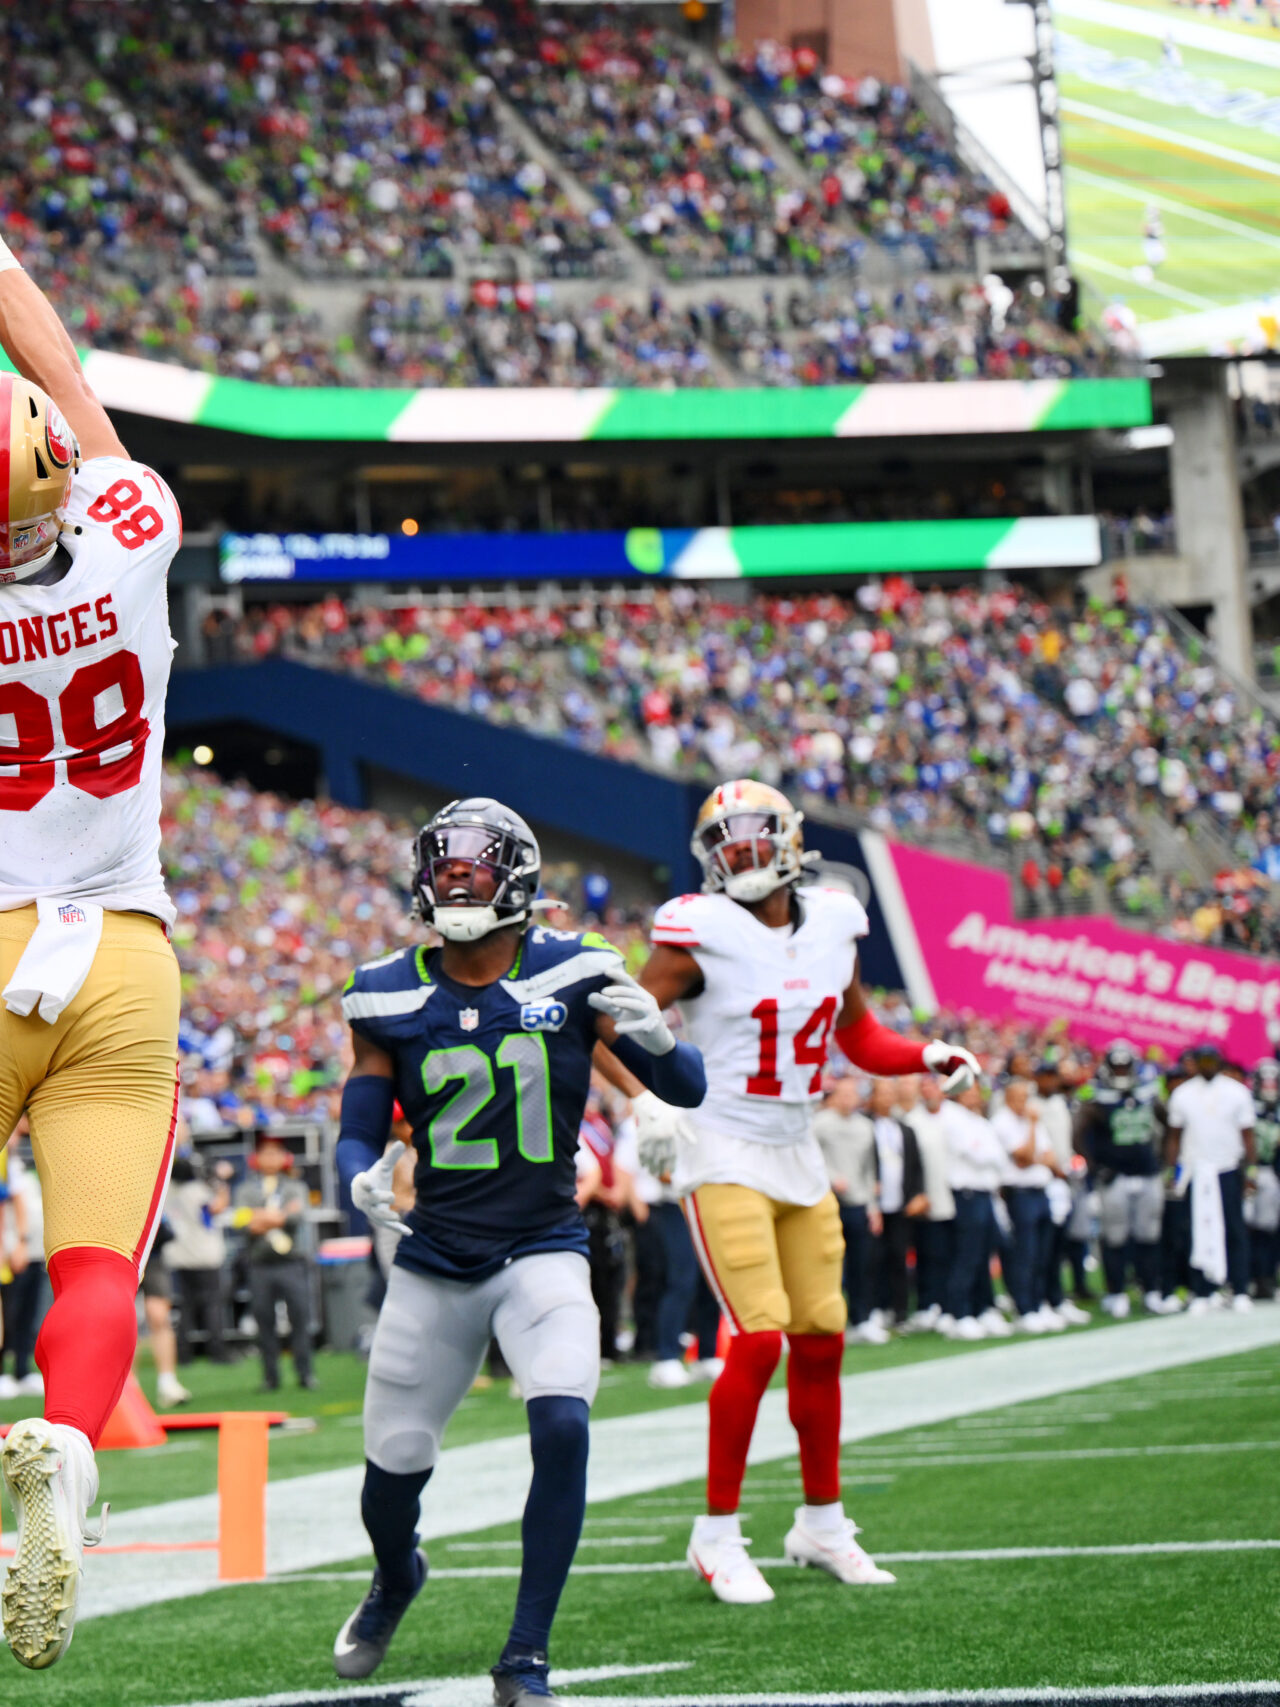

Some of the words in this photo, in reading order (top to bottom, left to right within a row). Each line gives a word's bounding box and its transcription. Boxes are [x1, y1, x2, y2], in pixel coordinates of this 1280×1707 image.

[86, 478, 164, 550] 88
[62, 912, 83, 923] NFL
[947, 912, 1174, 994] America's
[1177, 959, 1280, 1018] Best
[983, 957, 1092, 1006] Mobile
[1093, 982, 1231, 1039] Network
[523, 1004, 566, 1028] 50
[746, 996, 837, 1096] 14
[421, 1031, 554, 1170] 21
